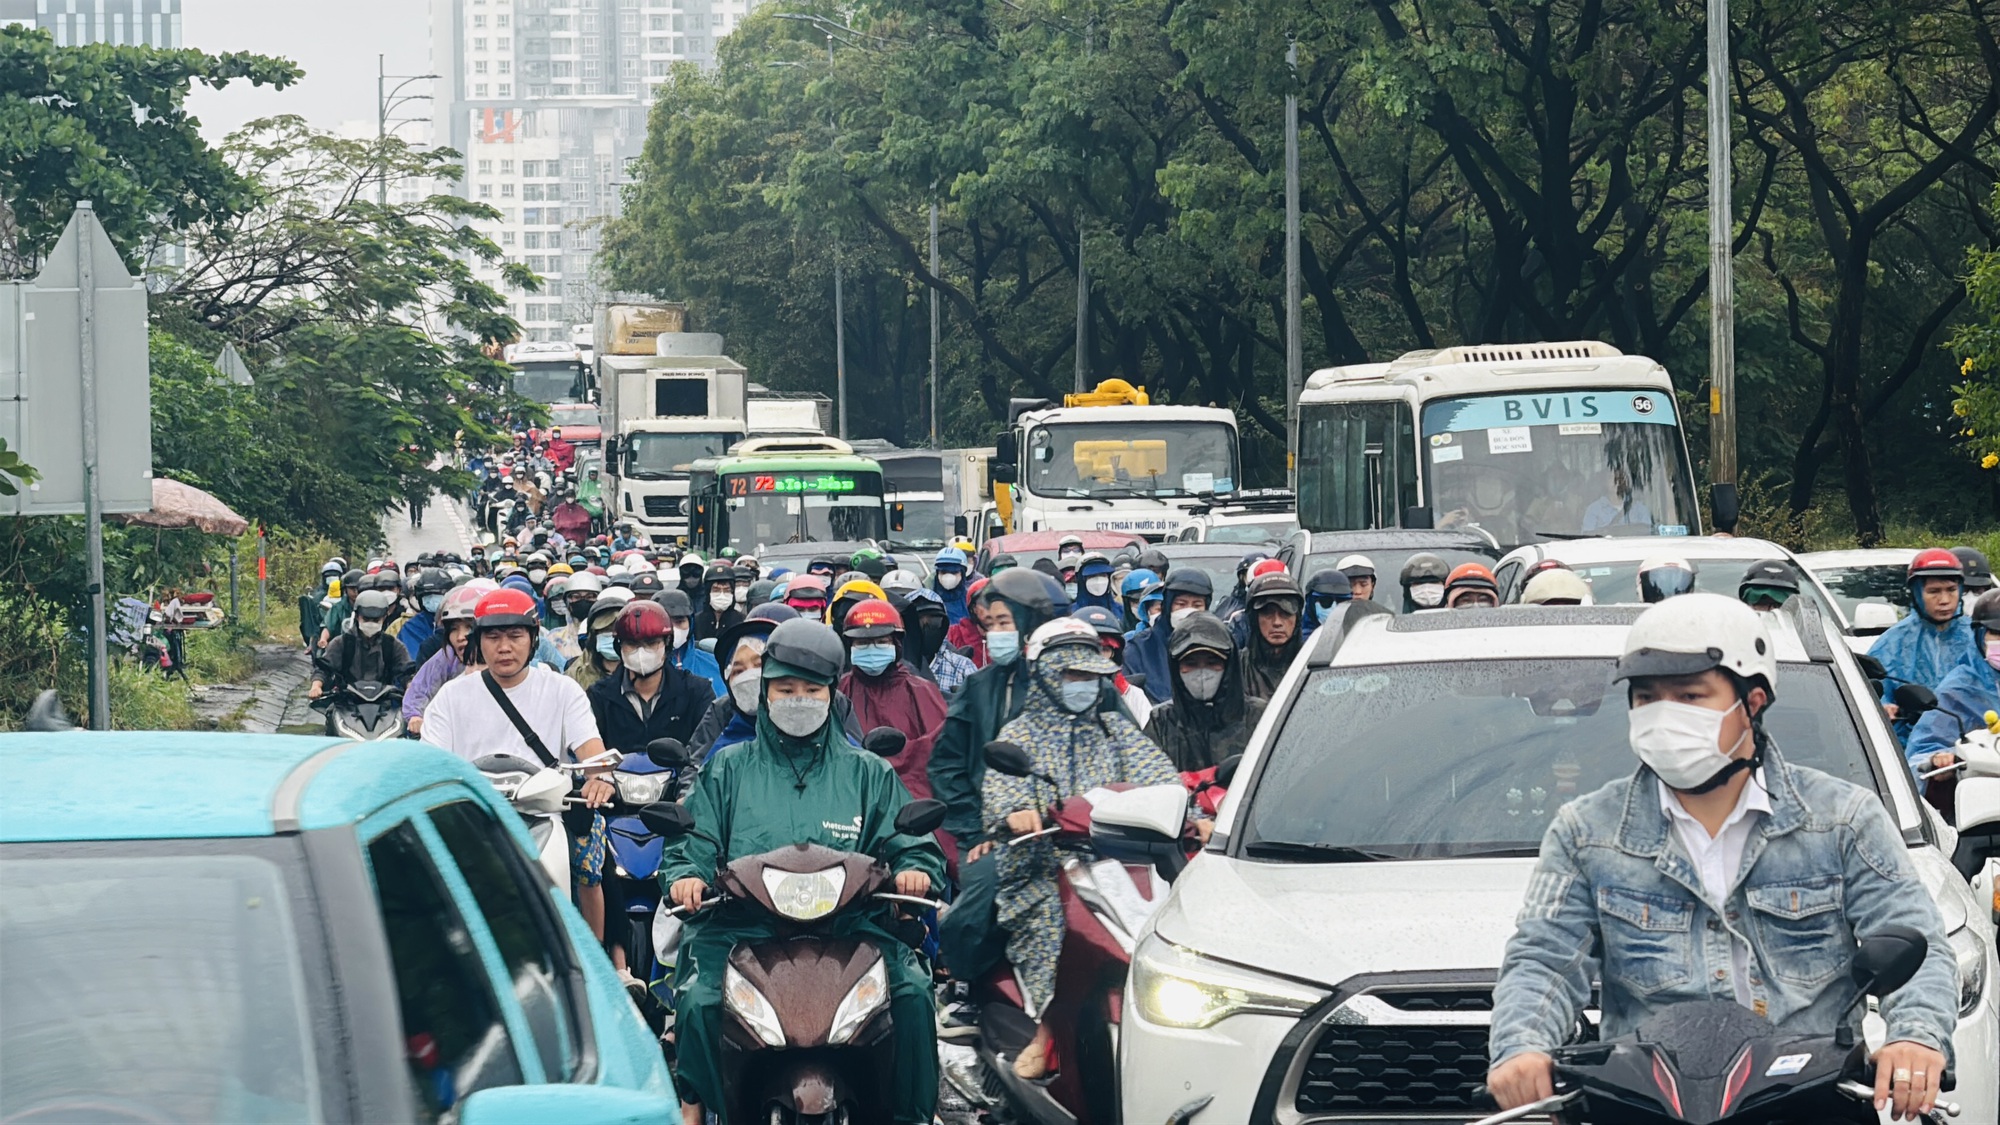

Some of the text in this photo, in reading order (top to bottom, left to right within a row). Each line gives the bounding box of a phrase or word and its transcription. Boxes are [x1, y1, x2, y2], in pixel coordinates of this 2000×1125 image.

[1503, 396, 1599, 421] BVIS
[1634, 400, 1652, 411] 56
[730, 477, 747, 495] 72
[755, 476, 775, 490] 72
[1240, 487, 1291, 498] Blue Storm
[1096, 521, 1109, 530] CTY
